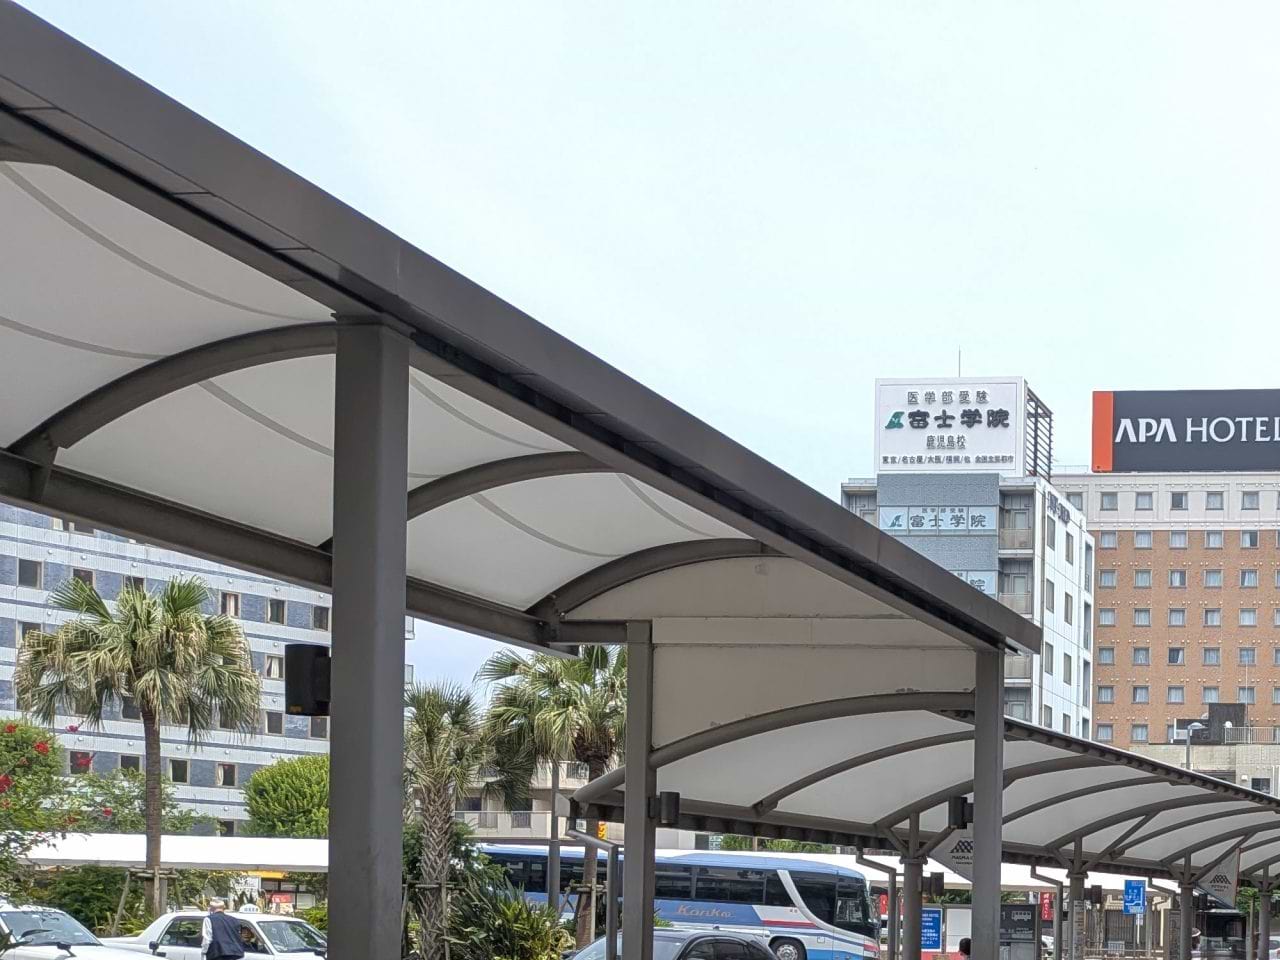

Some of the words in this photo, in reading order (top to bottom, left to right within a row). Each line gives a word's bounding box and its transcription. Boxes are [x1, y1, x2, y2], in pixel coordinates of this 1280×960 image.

[907, 390, 989, 405] 医学部受験
[907, 408, 1010, 429] 富士学院
[1115, 418, 1177, 443] APA
[910, 514, 987, 529] 富士学院
